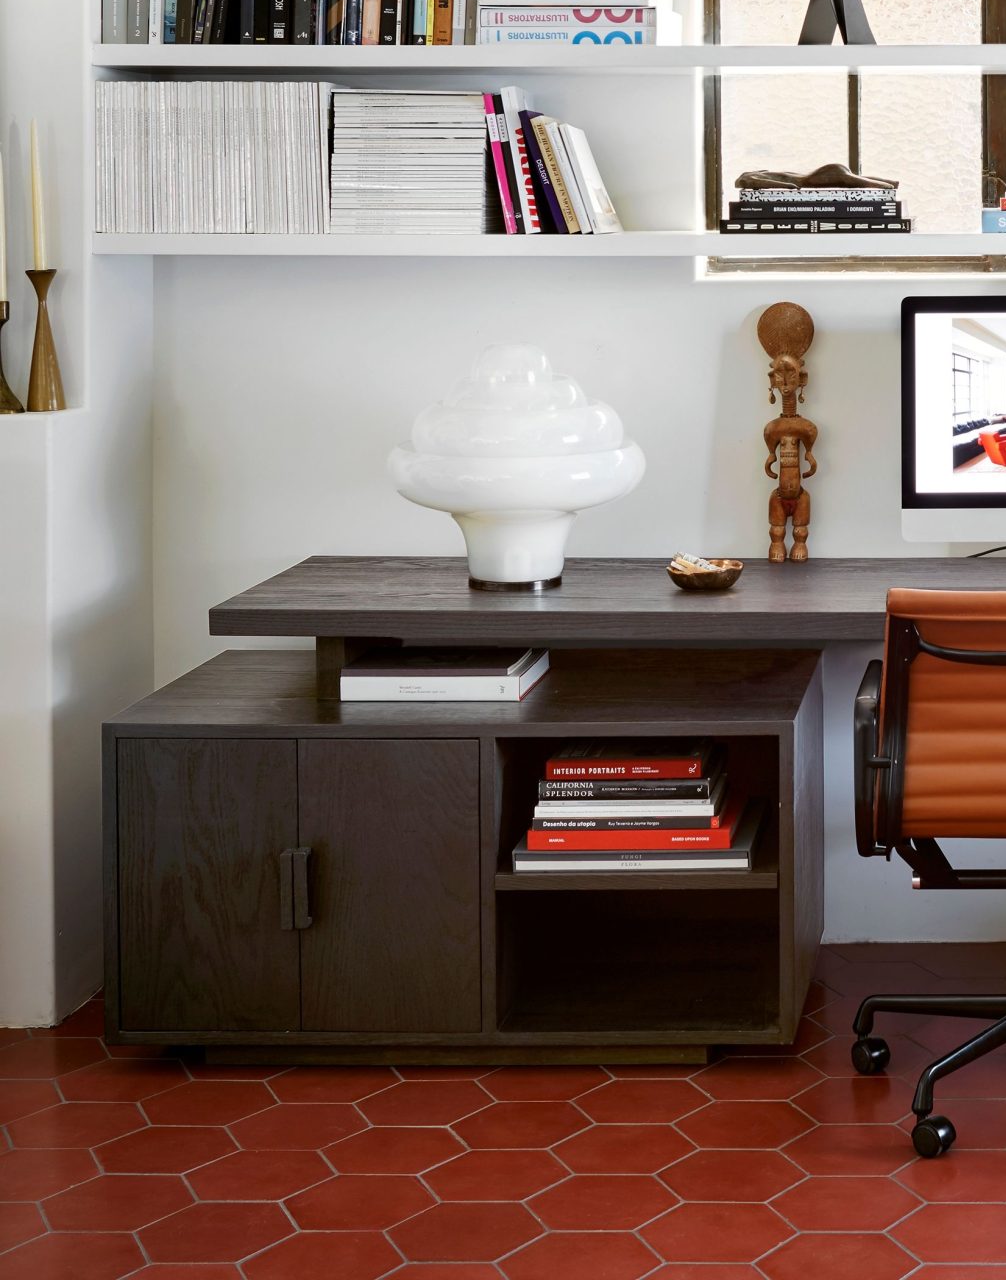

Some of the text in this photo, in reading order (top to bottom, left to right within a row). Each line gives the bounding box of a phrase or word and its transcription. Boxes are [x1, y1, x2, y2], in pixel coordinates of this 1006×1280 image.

[535, 158, 550, 185] DELIGHT
[553, 767, 626, 776] INTERIOR PORTRAITS
